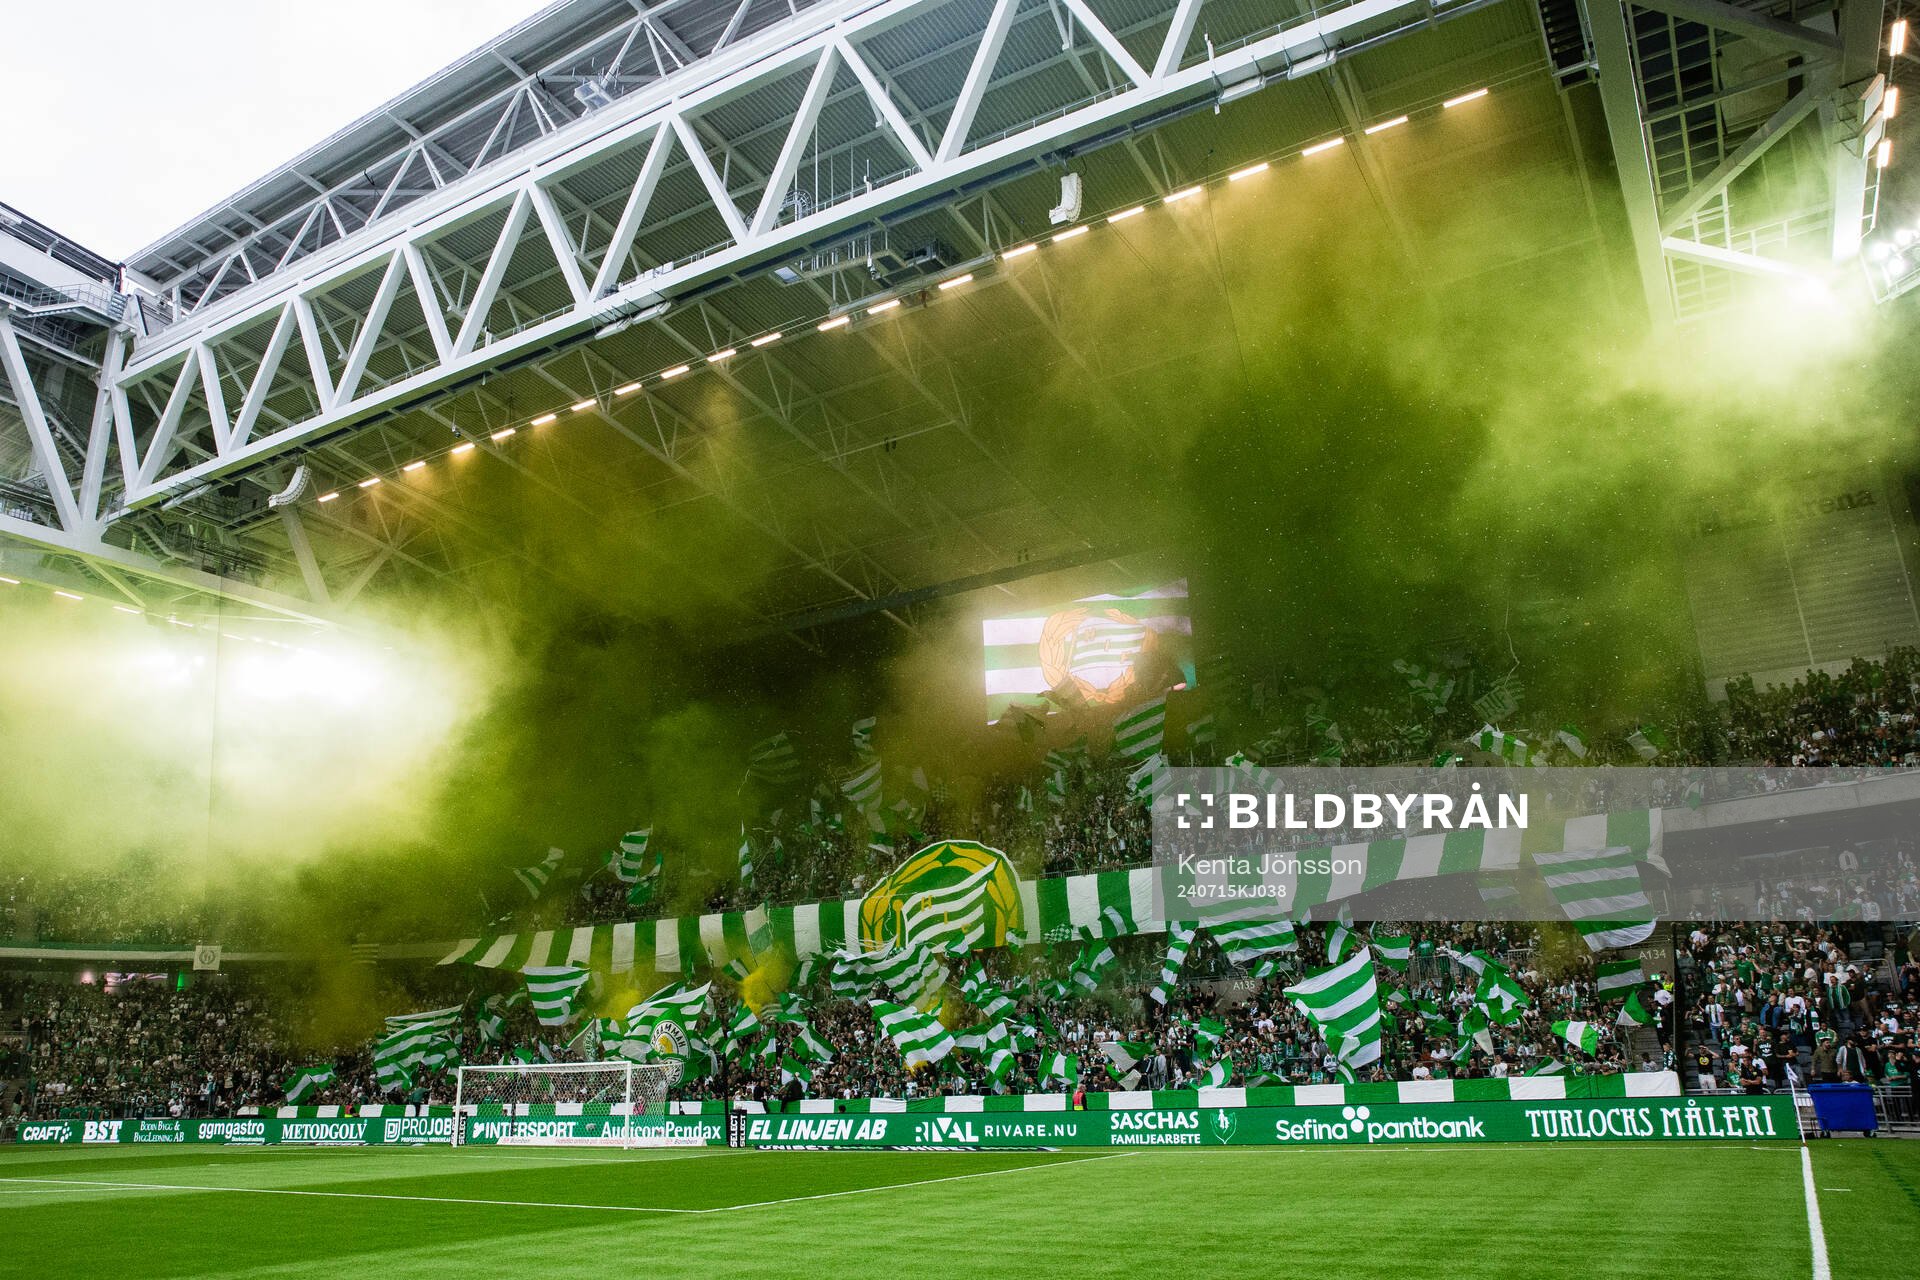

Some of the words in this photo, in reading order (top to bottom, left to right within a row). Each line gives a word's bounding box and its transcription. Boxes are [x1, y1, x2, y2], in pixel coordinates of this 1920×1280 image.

[1640, 949, 1666, 959] A134
[1233, 980, 1255, 991] A135
[401, 1117, 452, 1136] PROJOB
[1110, 1111, 1199, 1130] SASCHAS
[1659, 1098, 1777, 1138] MÅLERI
[23, 1126, 62, 1141] CRAFT
[82, 1121, 122, 1140] BST
[281, 1122, 367, 1140] METODGOLV
[458, 1116, 467, 1145] SELECT
[485, 1121, 577, 1139] INTERSPORT
[730, 1114, 738, 1148] SELECT
[749, 1119, 773, 1140] EL
[777, 1119, 853, 1140] LINJEN
[854, 1119, 888, 1140] AB
[915, 1117, 979, 1143] RIVAL
[984, 1124, 1077, 1137] RIVARE.NU
[1276, 1119, 1348, 1141] Sefina
[1367, 1115, 1486, 1143] pantbank
[1111, 1133, 1200, 1145] FAMILJEARBETE
